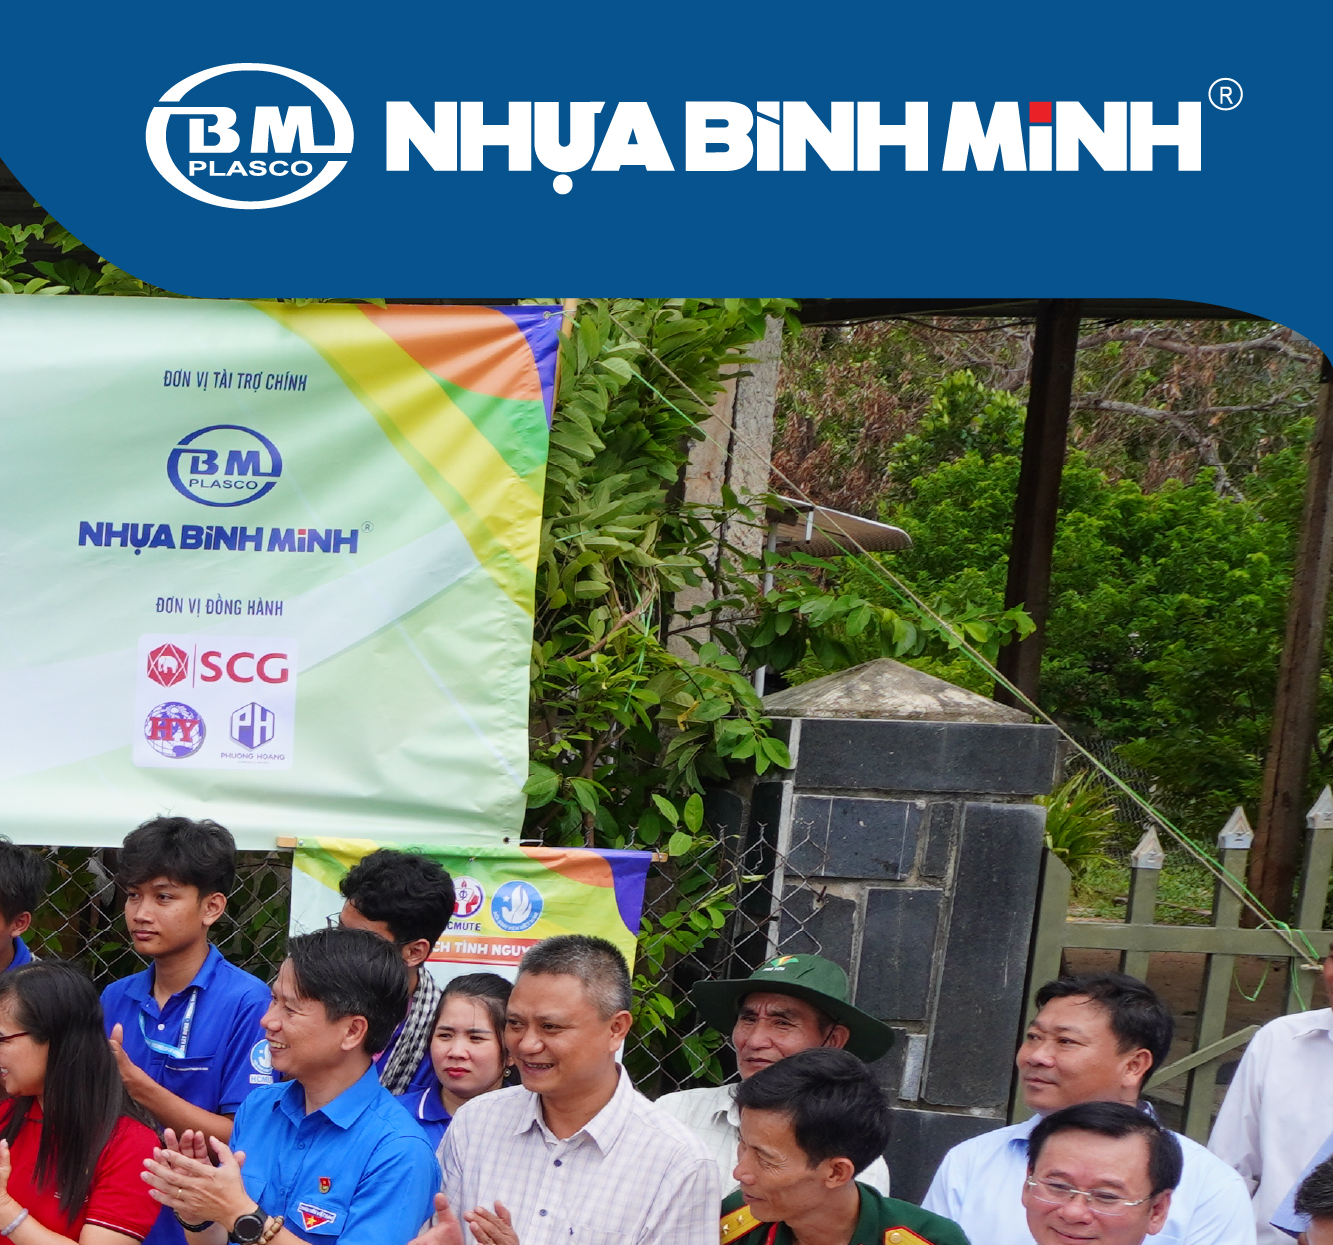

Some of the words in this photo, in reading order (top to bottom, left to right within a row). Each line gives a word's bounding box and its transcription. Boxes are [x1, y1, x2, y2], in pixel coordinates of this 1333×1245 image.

[163, 369, 190, 388] ĐƠN
[196, 371, 208, 391] VỊ
[213, 368, 232, 389] TÀI
[237, 371, 263, 393] TRỢ
[265, 370, 308, 391] CHÍNH
[187, 449, 263, 477] BM
[189, 478, 258, 490] PLASCO
[78, 521, 176, 555] NHỰA
[156, 596, 183, 614] ĐƠN
[189, 598, 200, 618] VỊ
[205, 594, 242, 616] ĐỒNG
[247, 597, 284, 616] HÀNH
[200, 651, 289, 684] SCG
[147, 716, 200, 742] HY
[446, 921, 481, 931] CMUTE
[433, 941, 451, 952] CH
[454, 940, 488, 955] TÌNH
[491, 942, 531, 957] NGUY
